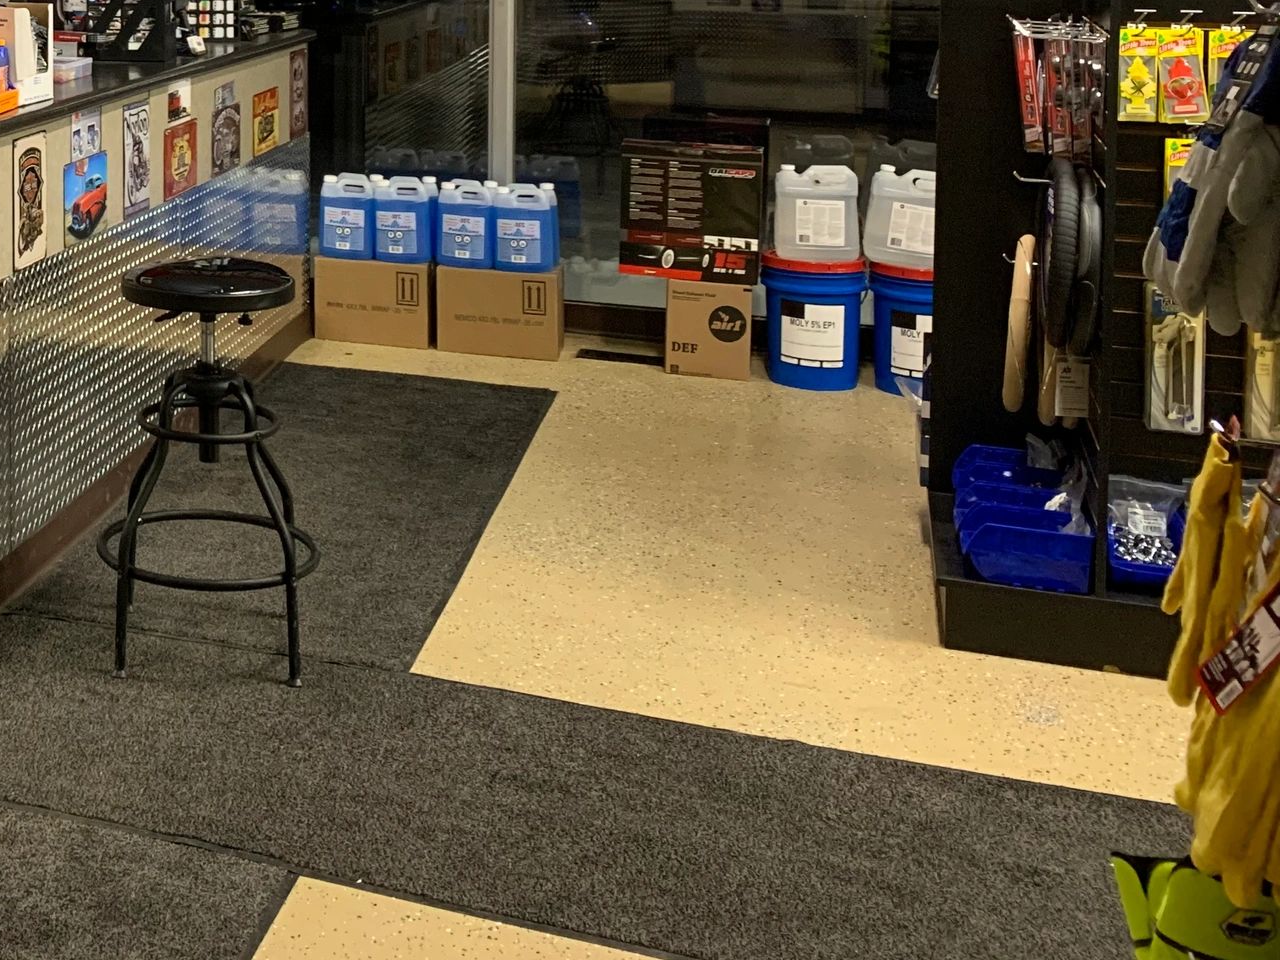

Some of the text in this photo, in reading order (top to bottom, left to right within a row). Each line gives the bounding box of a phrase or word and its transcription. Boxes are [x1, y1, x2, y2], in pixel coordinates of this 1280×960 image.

[1121, 41, 1138, 52] Little
[1159, 42, 1176, 53] Little
[790, 318, 836, 329] MOLY 5% EP1
[900, 328, 921, 339] MOLY
[672, 341, 699, 354] DEF
